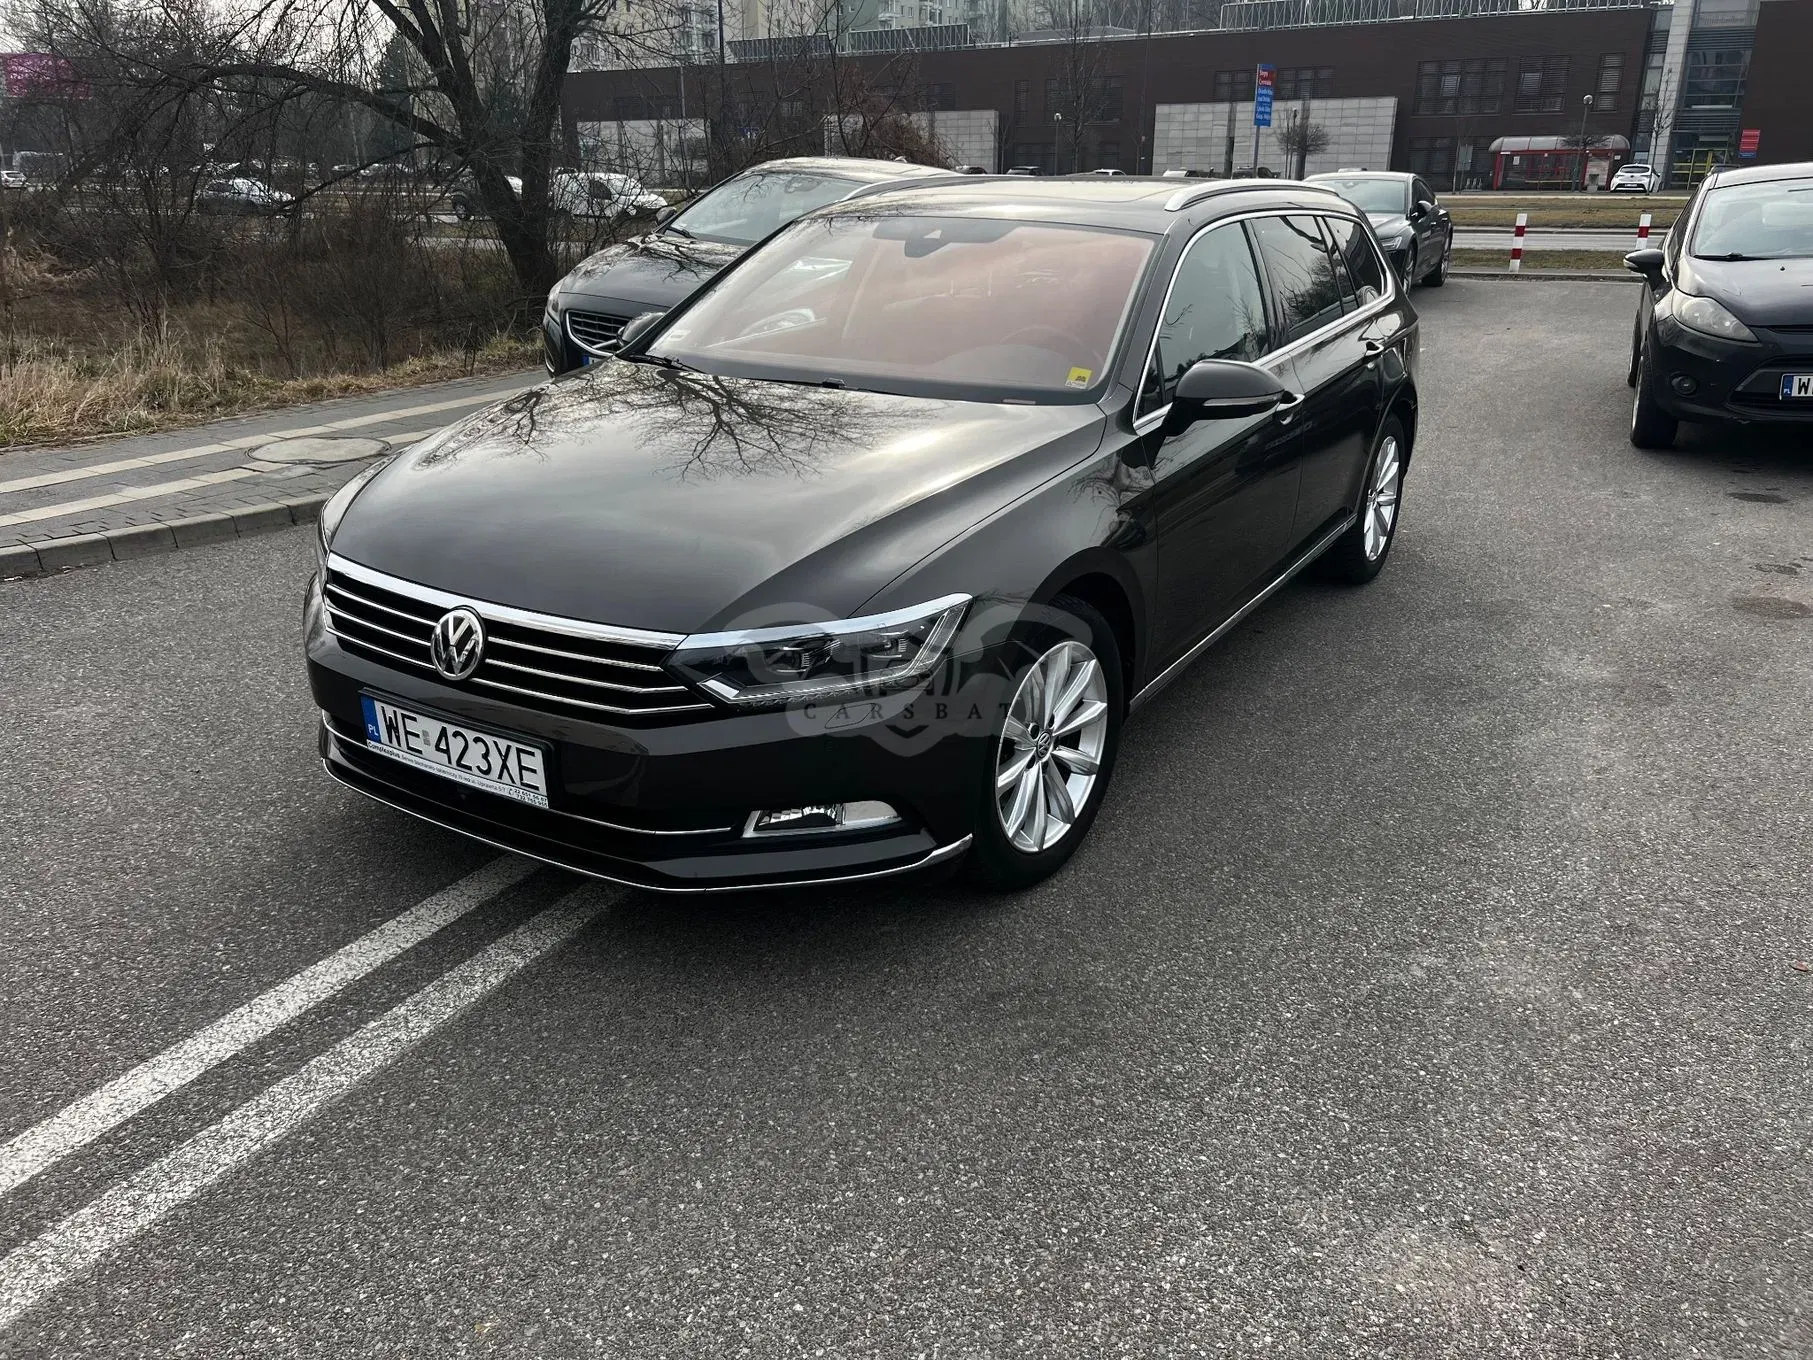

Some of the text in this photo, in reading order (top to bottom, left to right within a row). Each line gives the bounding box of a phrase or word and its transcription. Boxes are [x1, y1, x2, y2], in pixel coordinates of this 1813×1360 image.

[367, 723, 379, 737] PL
[381, 705, 423, 755] WE
[435, 726, 540, 791] 423XE
